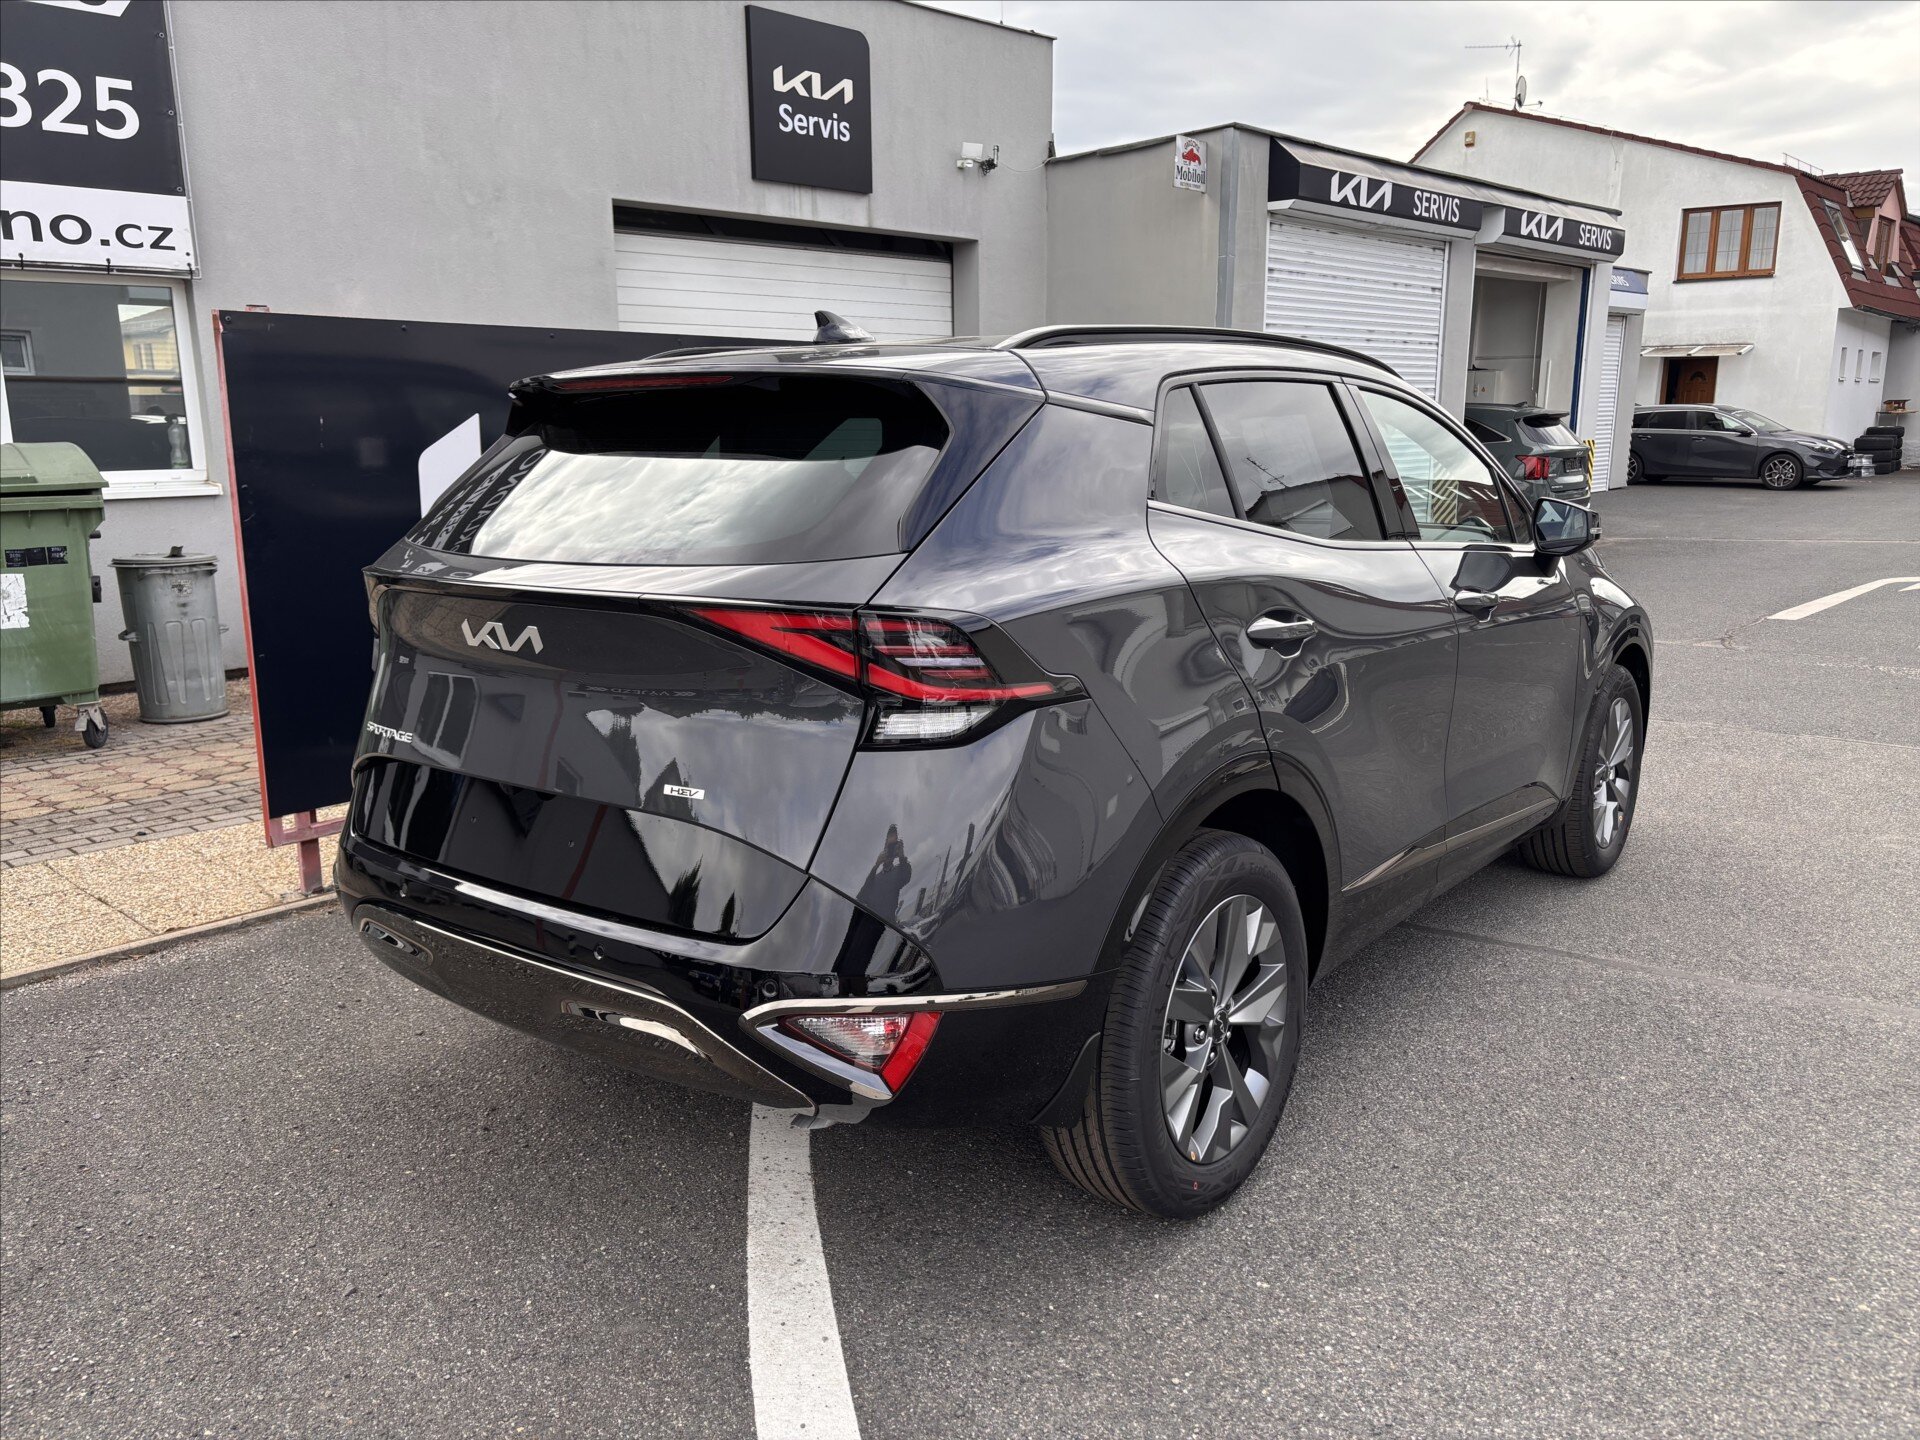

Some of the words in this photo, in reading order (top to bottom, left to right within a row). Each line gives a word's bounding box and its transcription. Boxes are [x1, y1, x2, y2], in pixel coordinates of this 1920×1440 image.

[0, 61, 140, 140] 325
[773, 65, 854, 105] KIA
[778, 103, 851, 142] Servis
[1176, 165, 1206, 185] Mobiloil
[1330, 171, 1393, 212] KIA
[1413, 190, 1460, 223] SERVIS
[0, 209, 176, 251] no.cz
[1520, 211, 1564, 242] KIA
[1578, 224, 1613, 250] SERVIS
[461, 618, 544, 655] KIA
[670, 786, 700, 797] HEV
